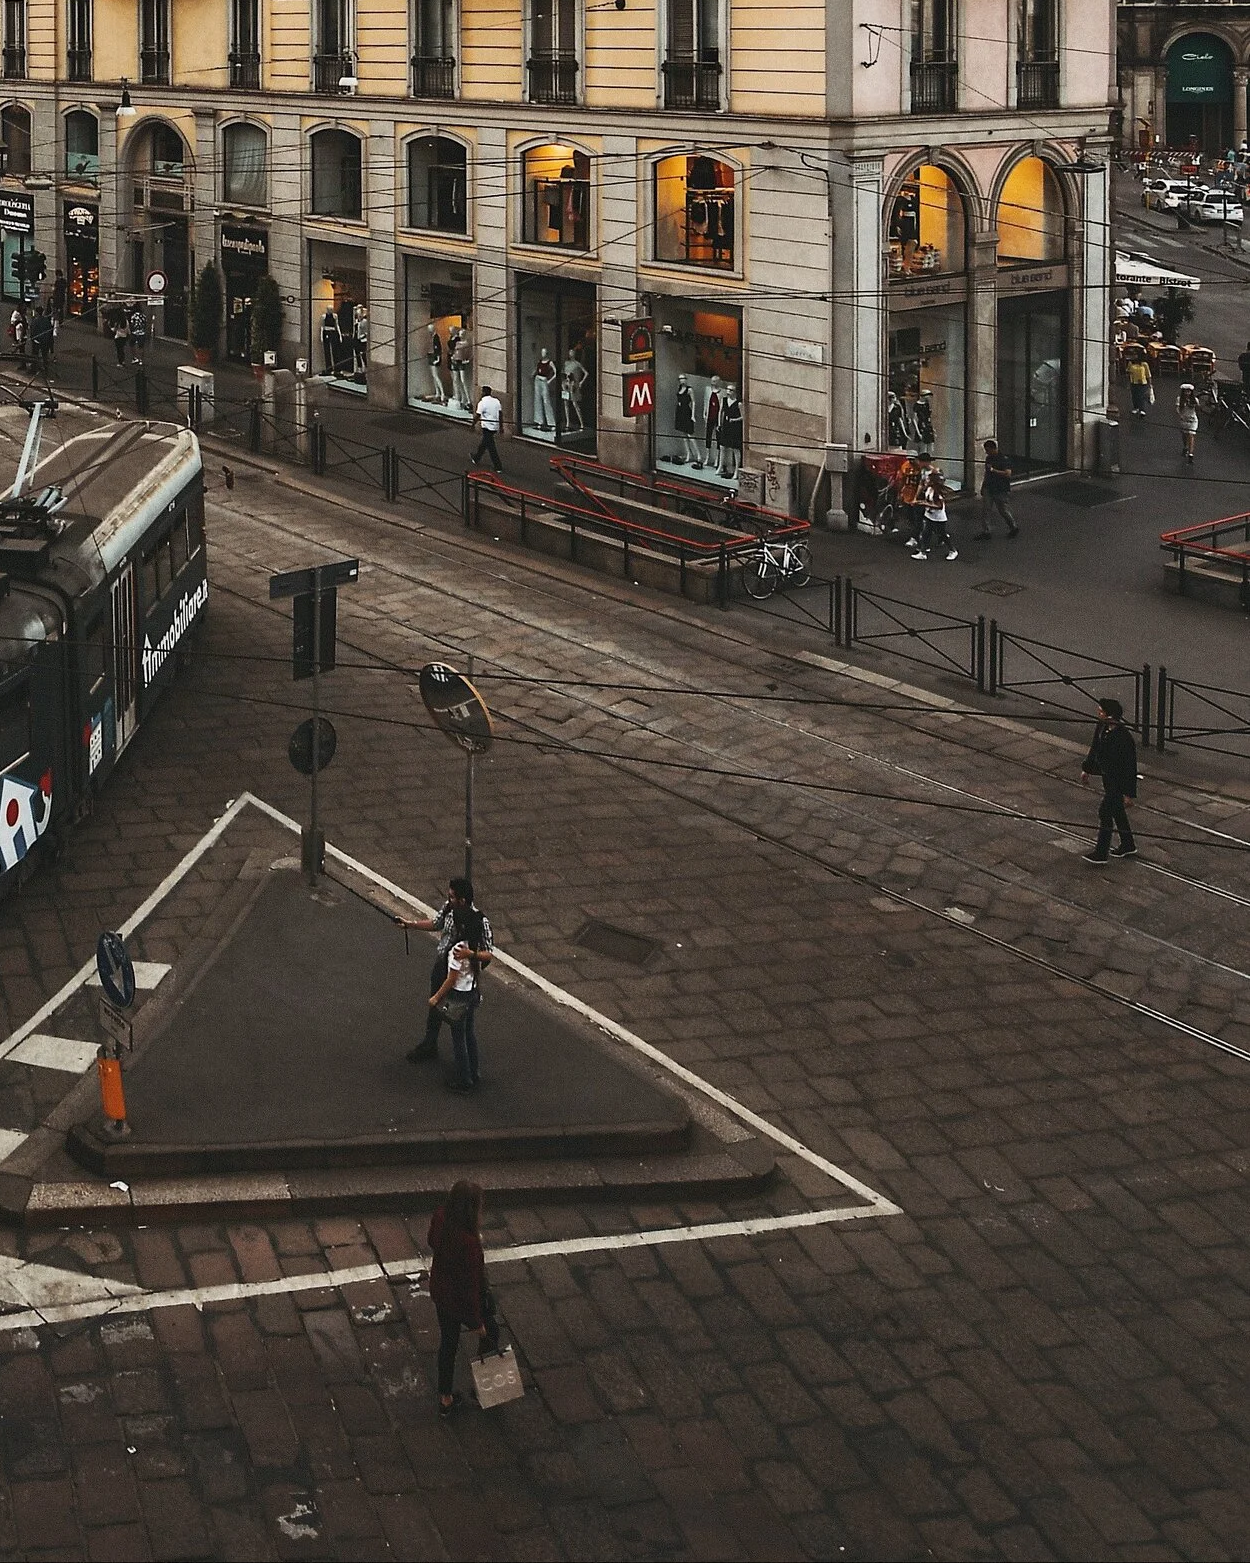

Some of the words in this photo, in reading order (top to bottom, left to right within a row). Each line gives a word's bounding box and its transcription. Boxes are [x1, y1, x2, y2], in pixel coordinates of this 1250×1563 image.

[1159, 276, 1192, 288] Bistrot
[629, 382, 653, 408] M
[480, 1370, 517, 1392] COS
